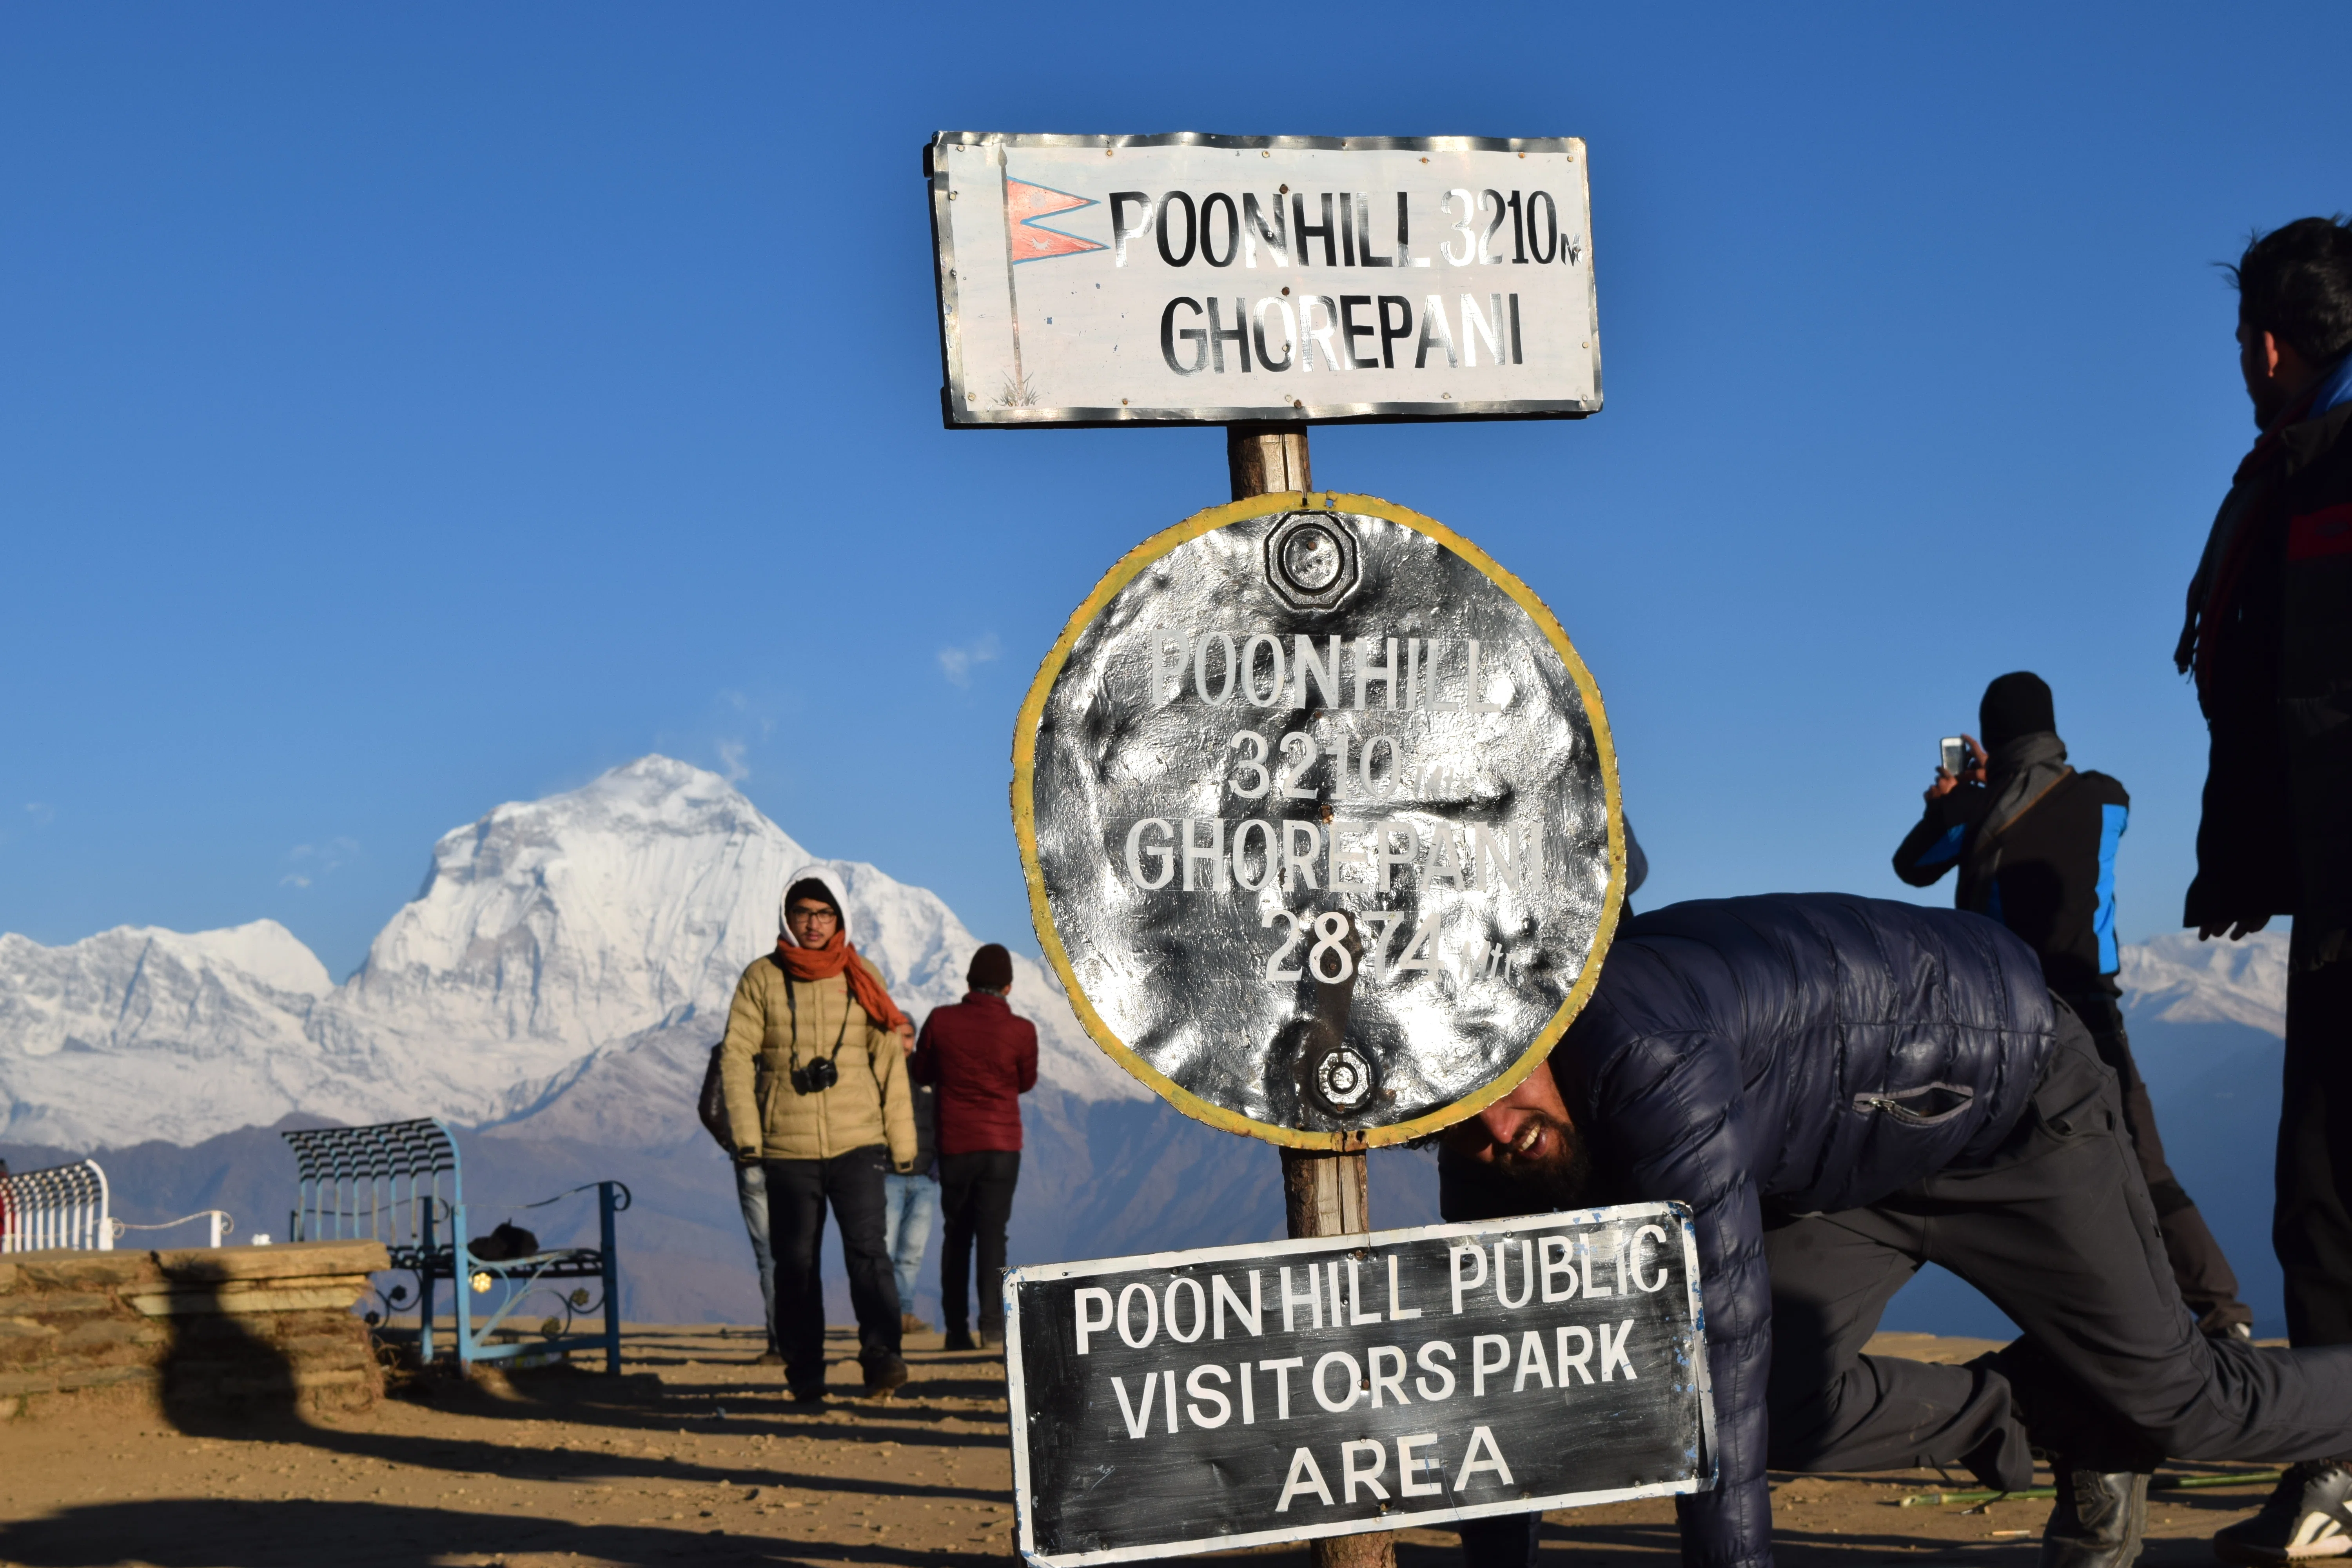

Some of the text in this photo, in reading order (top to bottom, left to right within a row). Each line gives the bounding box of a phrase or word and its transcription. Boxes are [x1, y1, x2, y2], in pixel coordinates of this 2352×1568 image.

[1109, 191, 1430, 268] POONHILL
[1160, 293, 1523, 376] GHOREPANI
[1152, 630, 1501, 713] POONHILL
[1229, 730, 1401, 800] 3210
[1126, 818, 1543, 892] GHOREPANI
[1261, 909, 1444, 984] 2874
[1450, 1225, 1668, 1314] PUBLIC
[1277, 1426, 1512, 1512] AREA
